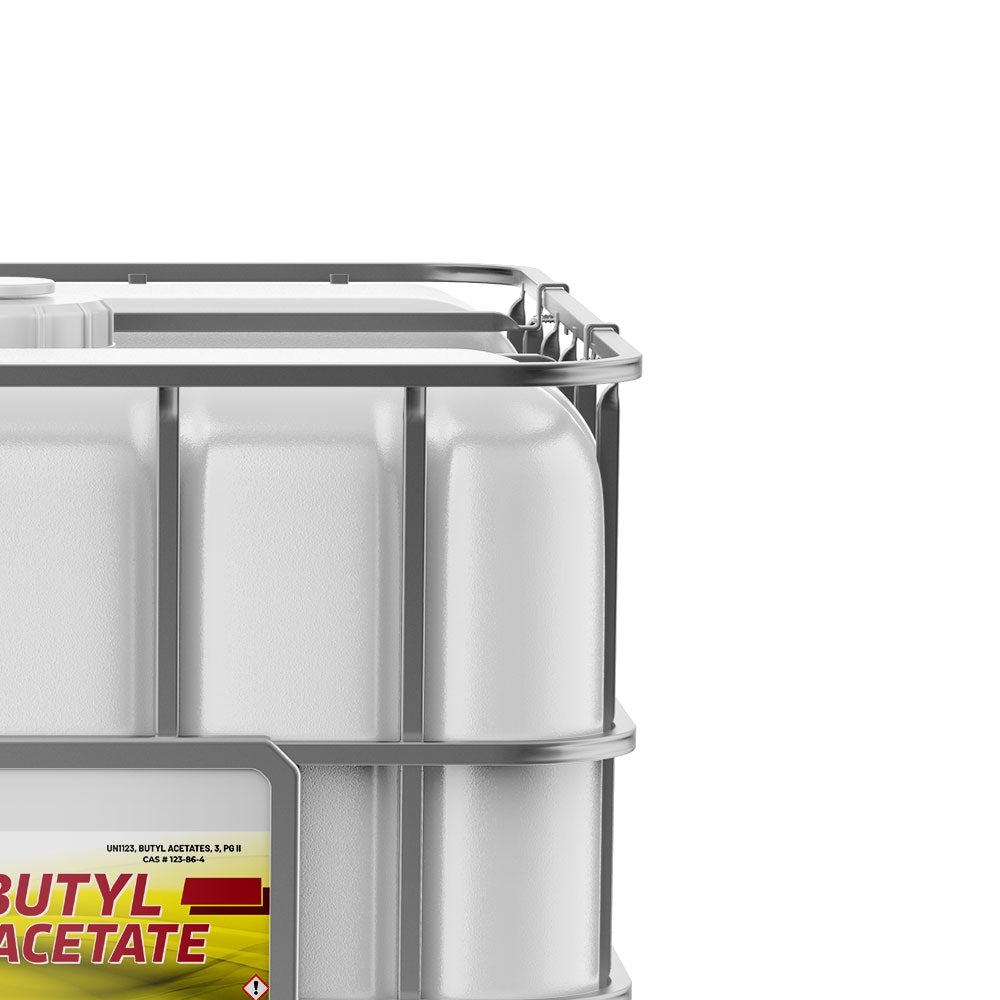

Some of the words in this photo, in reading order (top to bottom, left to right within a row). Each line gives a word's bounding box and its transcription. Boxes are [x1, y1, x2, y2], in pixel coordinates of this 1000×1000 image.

[106, 844, 137, 853] UN1123,
[138, 844, 166, 853] BUTYL
[168, 844, 213, 853] ACETATES,
[214, 844, 222, 853] 3,
[224, 844, 235, 853] PG
[236, 844, 242, 853] II
